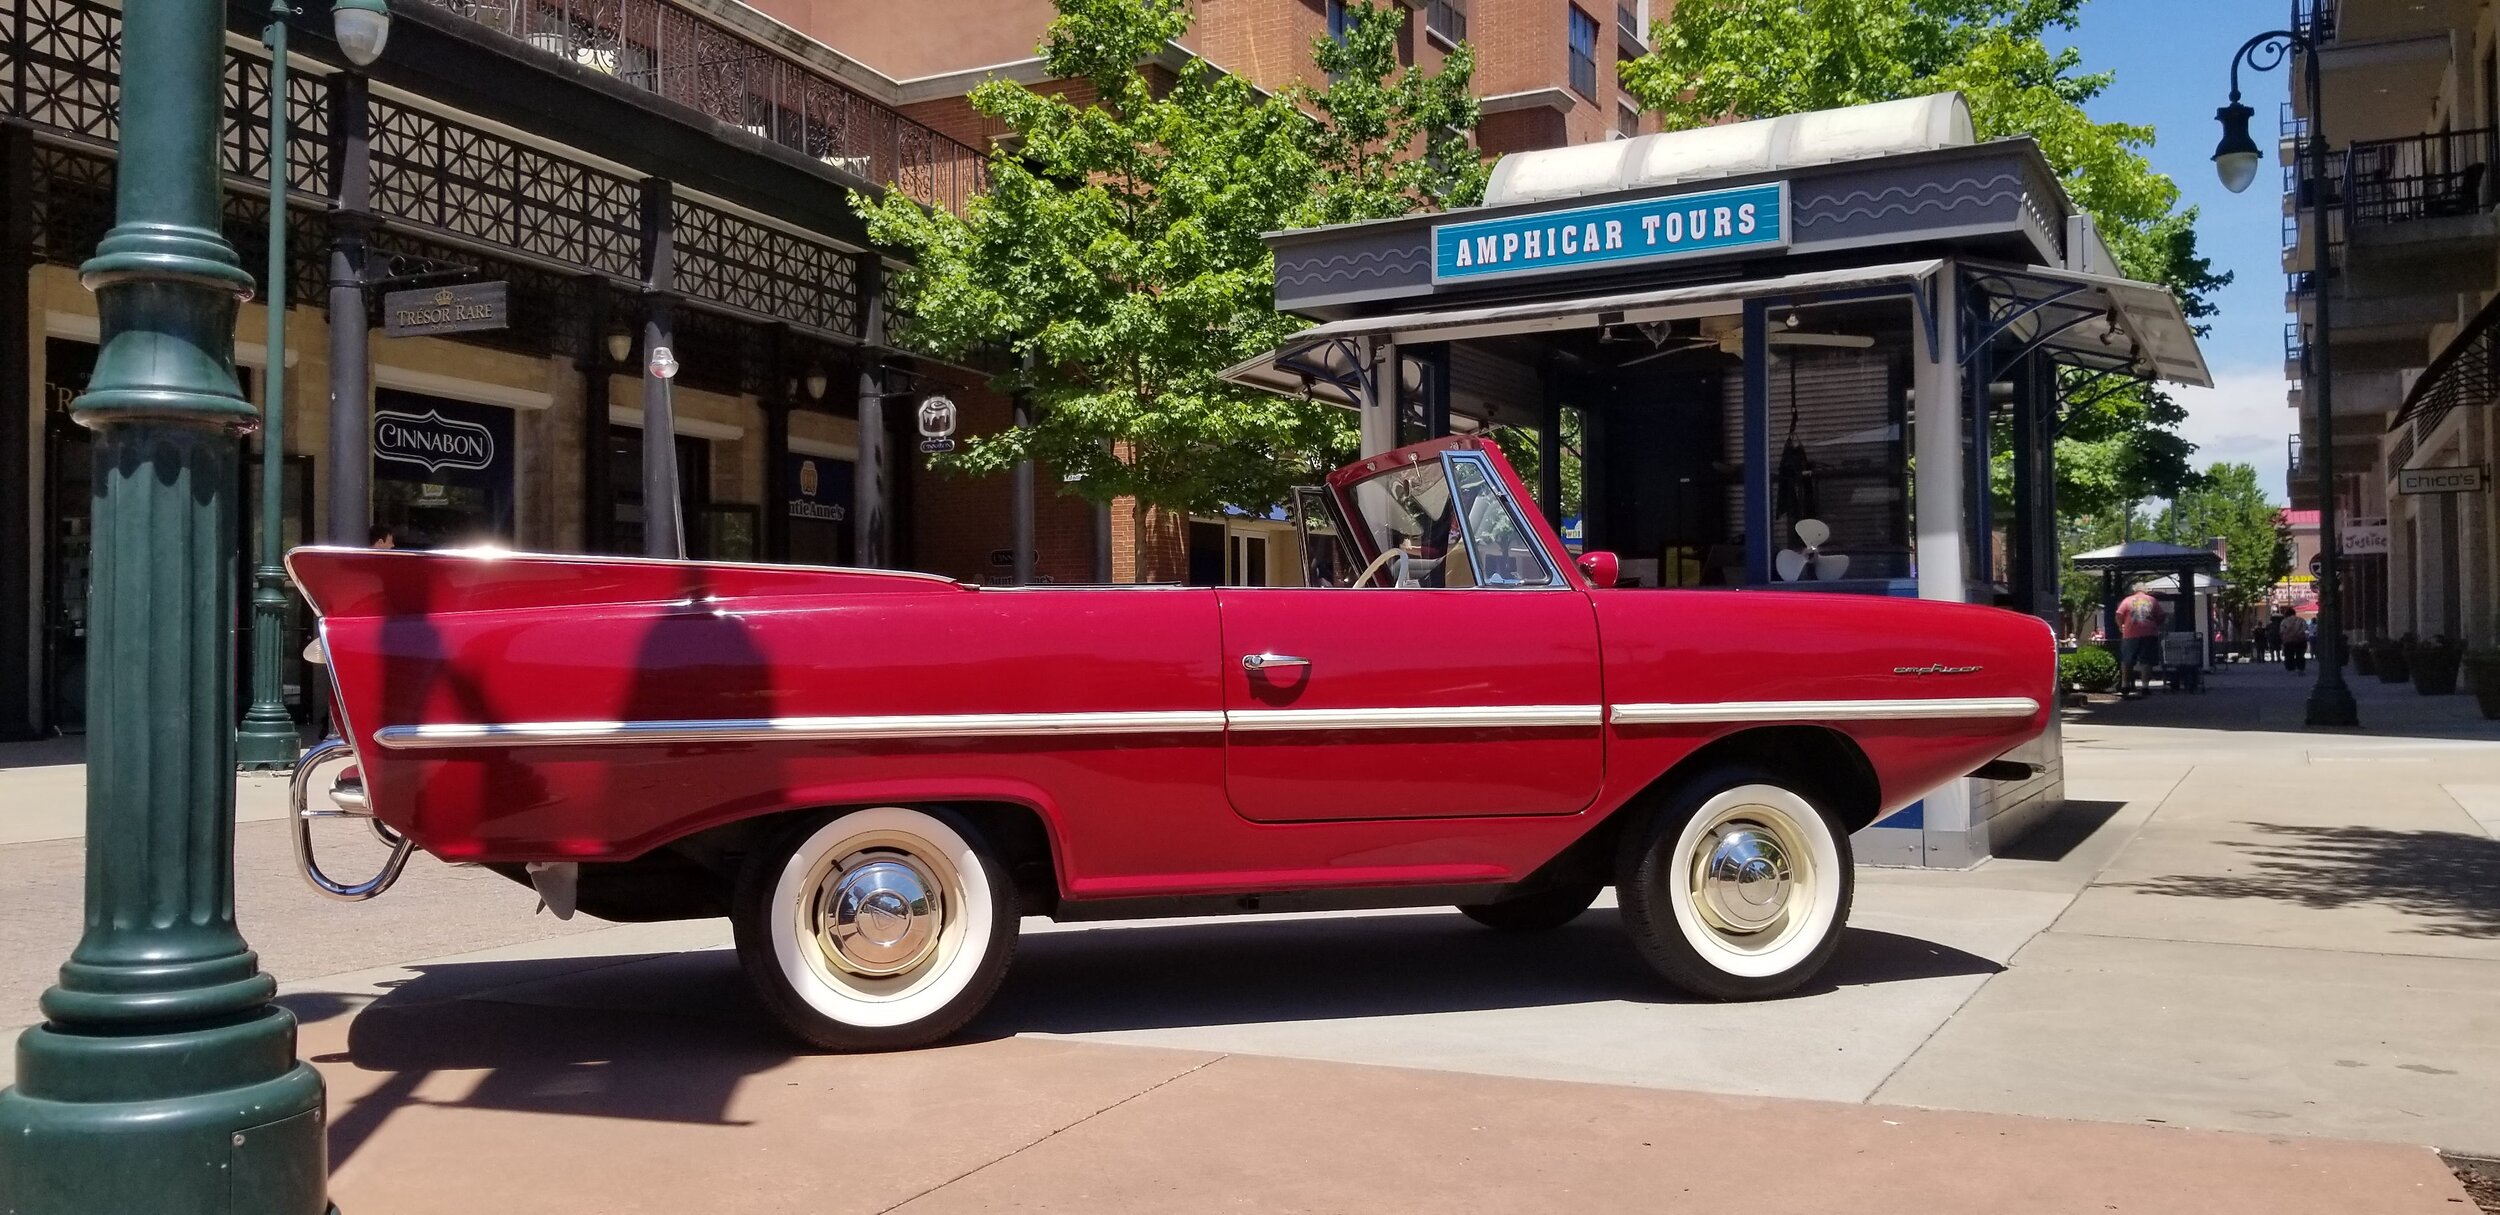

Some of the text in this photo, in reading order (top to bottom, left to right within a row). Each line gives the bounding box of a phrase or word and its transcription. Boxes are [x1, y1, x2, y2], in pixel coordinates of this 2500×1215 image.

[1456, 203, 1756, 267] AMPHICAR TOURS
[396, 303, 493, 326] TRÉSOR RARE
[380, 423, 484, 458] CINNABON
